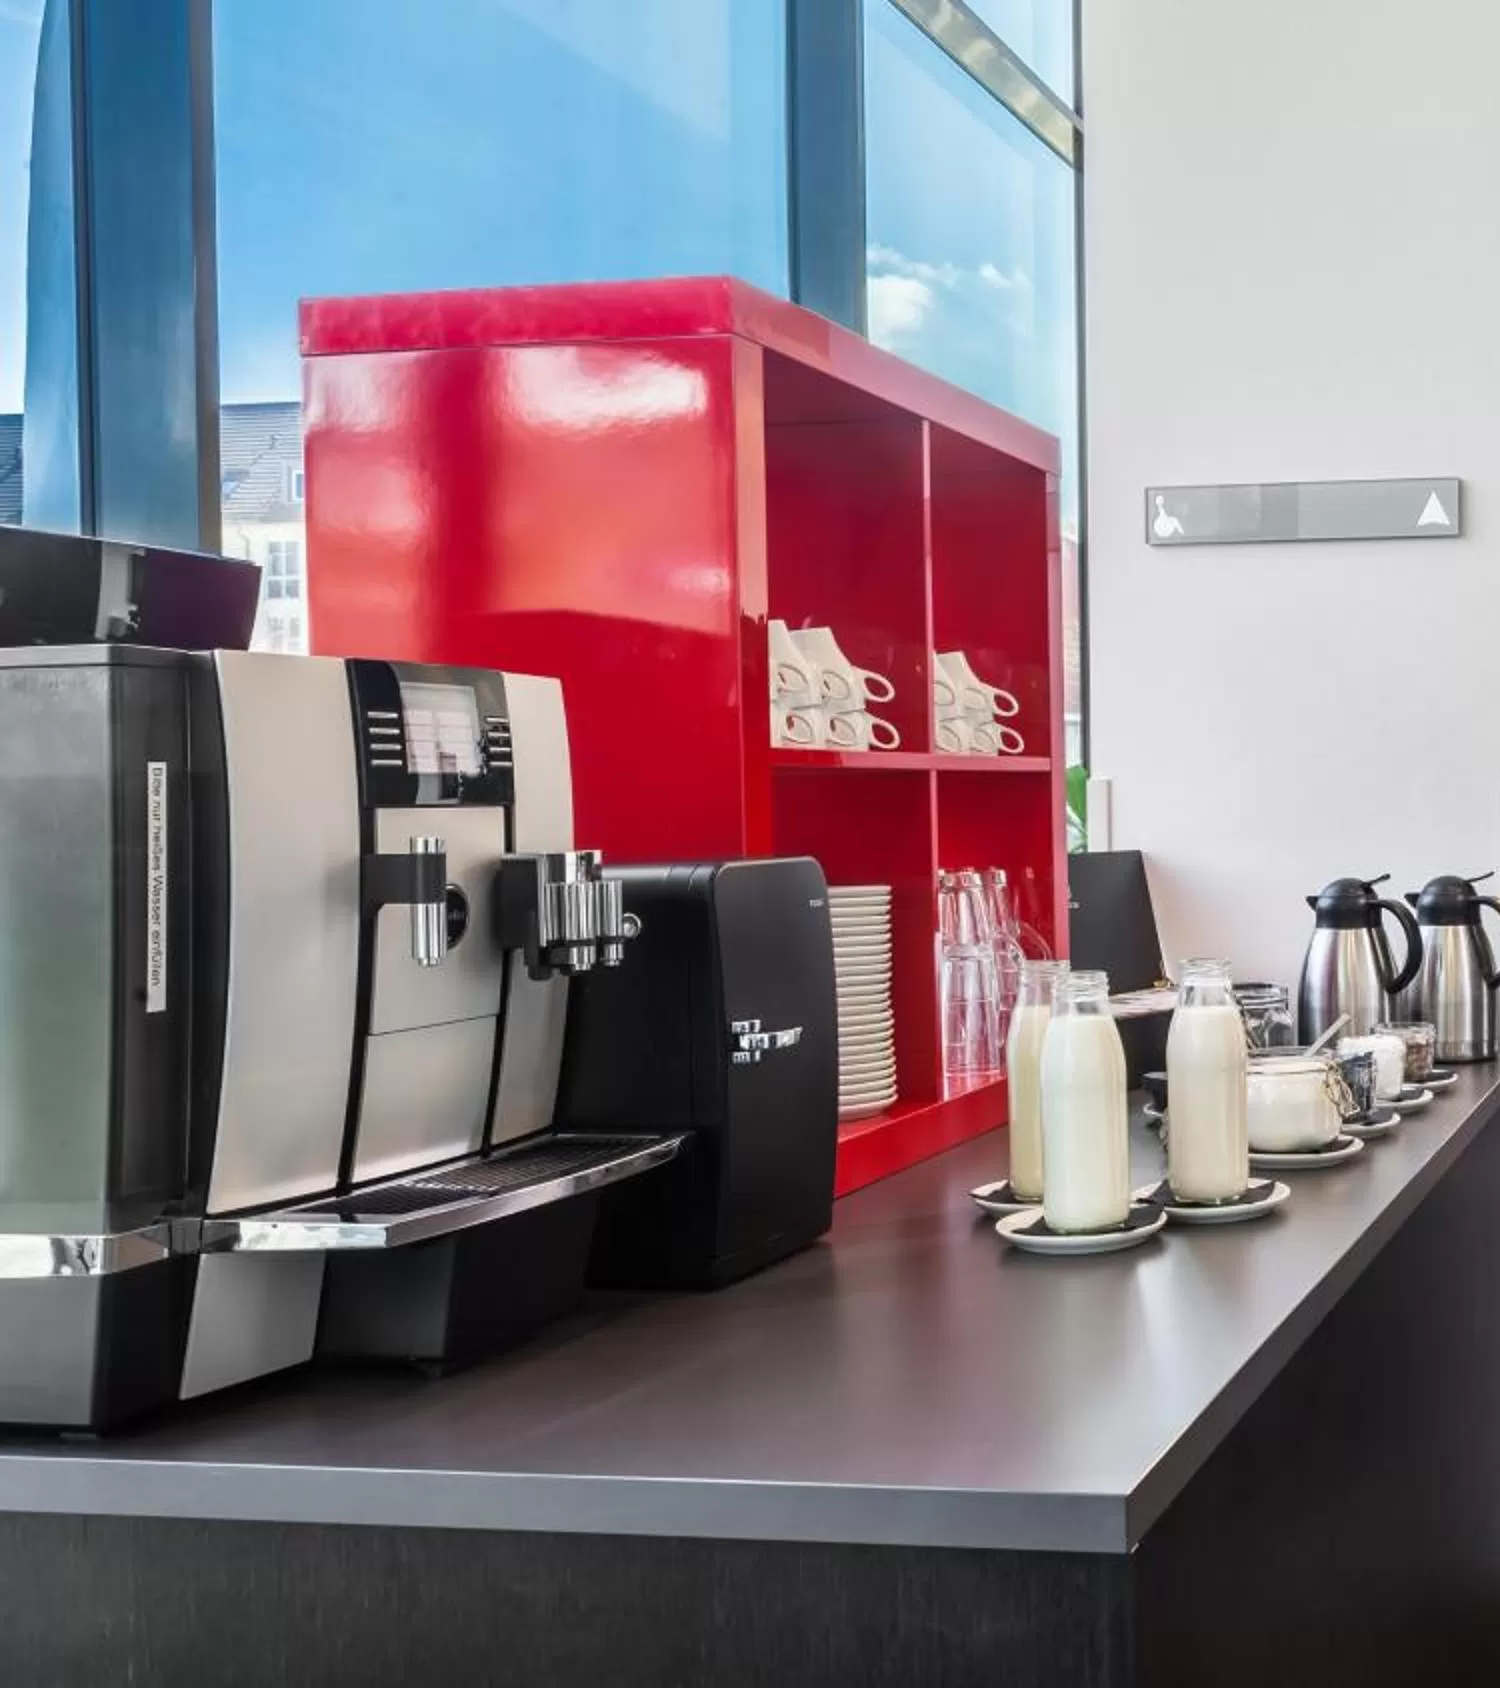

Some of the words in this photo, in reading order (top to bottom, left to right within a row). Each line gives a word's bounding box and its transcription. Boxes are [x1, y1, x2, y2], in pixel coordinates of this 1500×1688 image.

[152, 801, 161, 823] nur
[152, 875, 164, 925] Wasser
[151, 930, 163, 987] einfüllen
